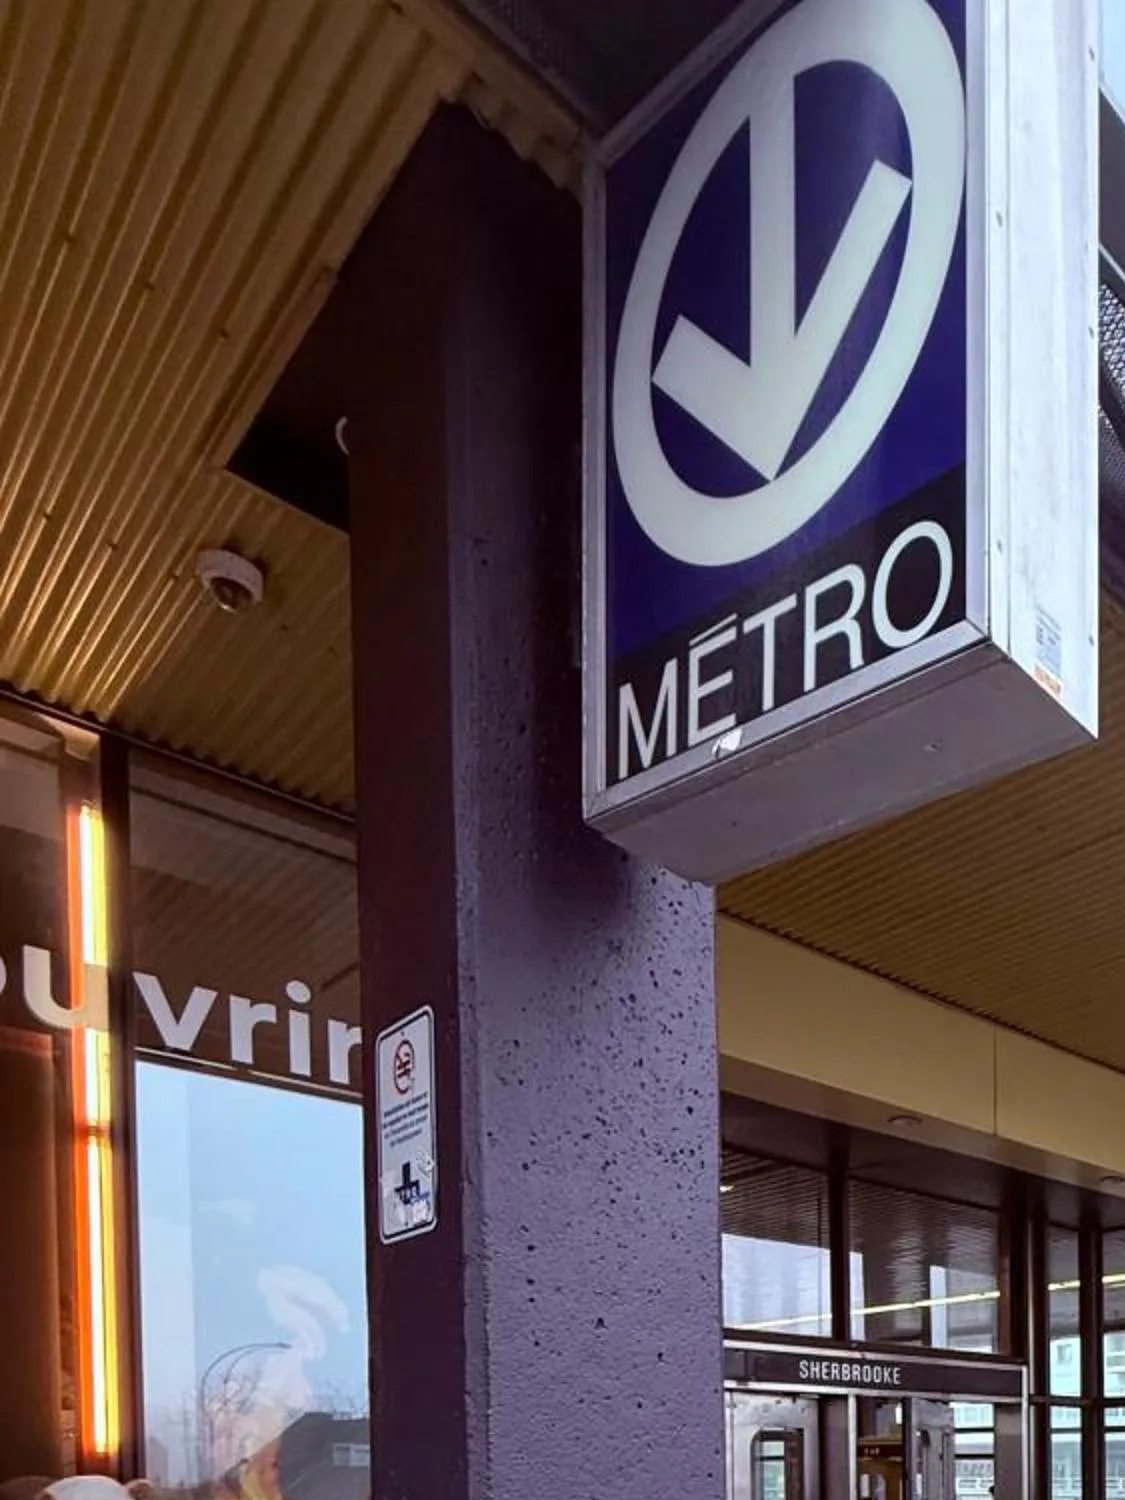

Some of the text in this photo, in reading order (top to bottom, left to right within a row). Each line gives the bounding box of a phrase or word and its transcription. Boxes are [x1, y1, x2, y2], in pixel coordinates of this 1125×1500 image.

[618, 520, 953, 779] MÉTRO
[0, 944, 362, 1085] uvrir
[799, 1359, 901, 1385] SHERBROOKE
